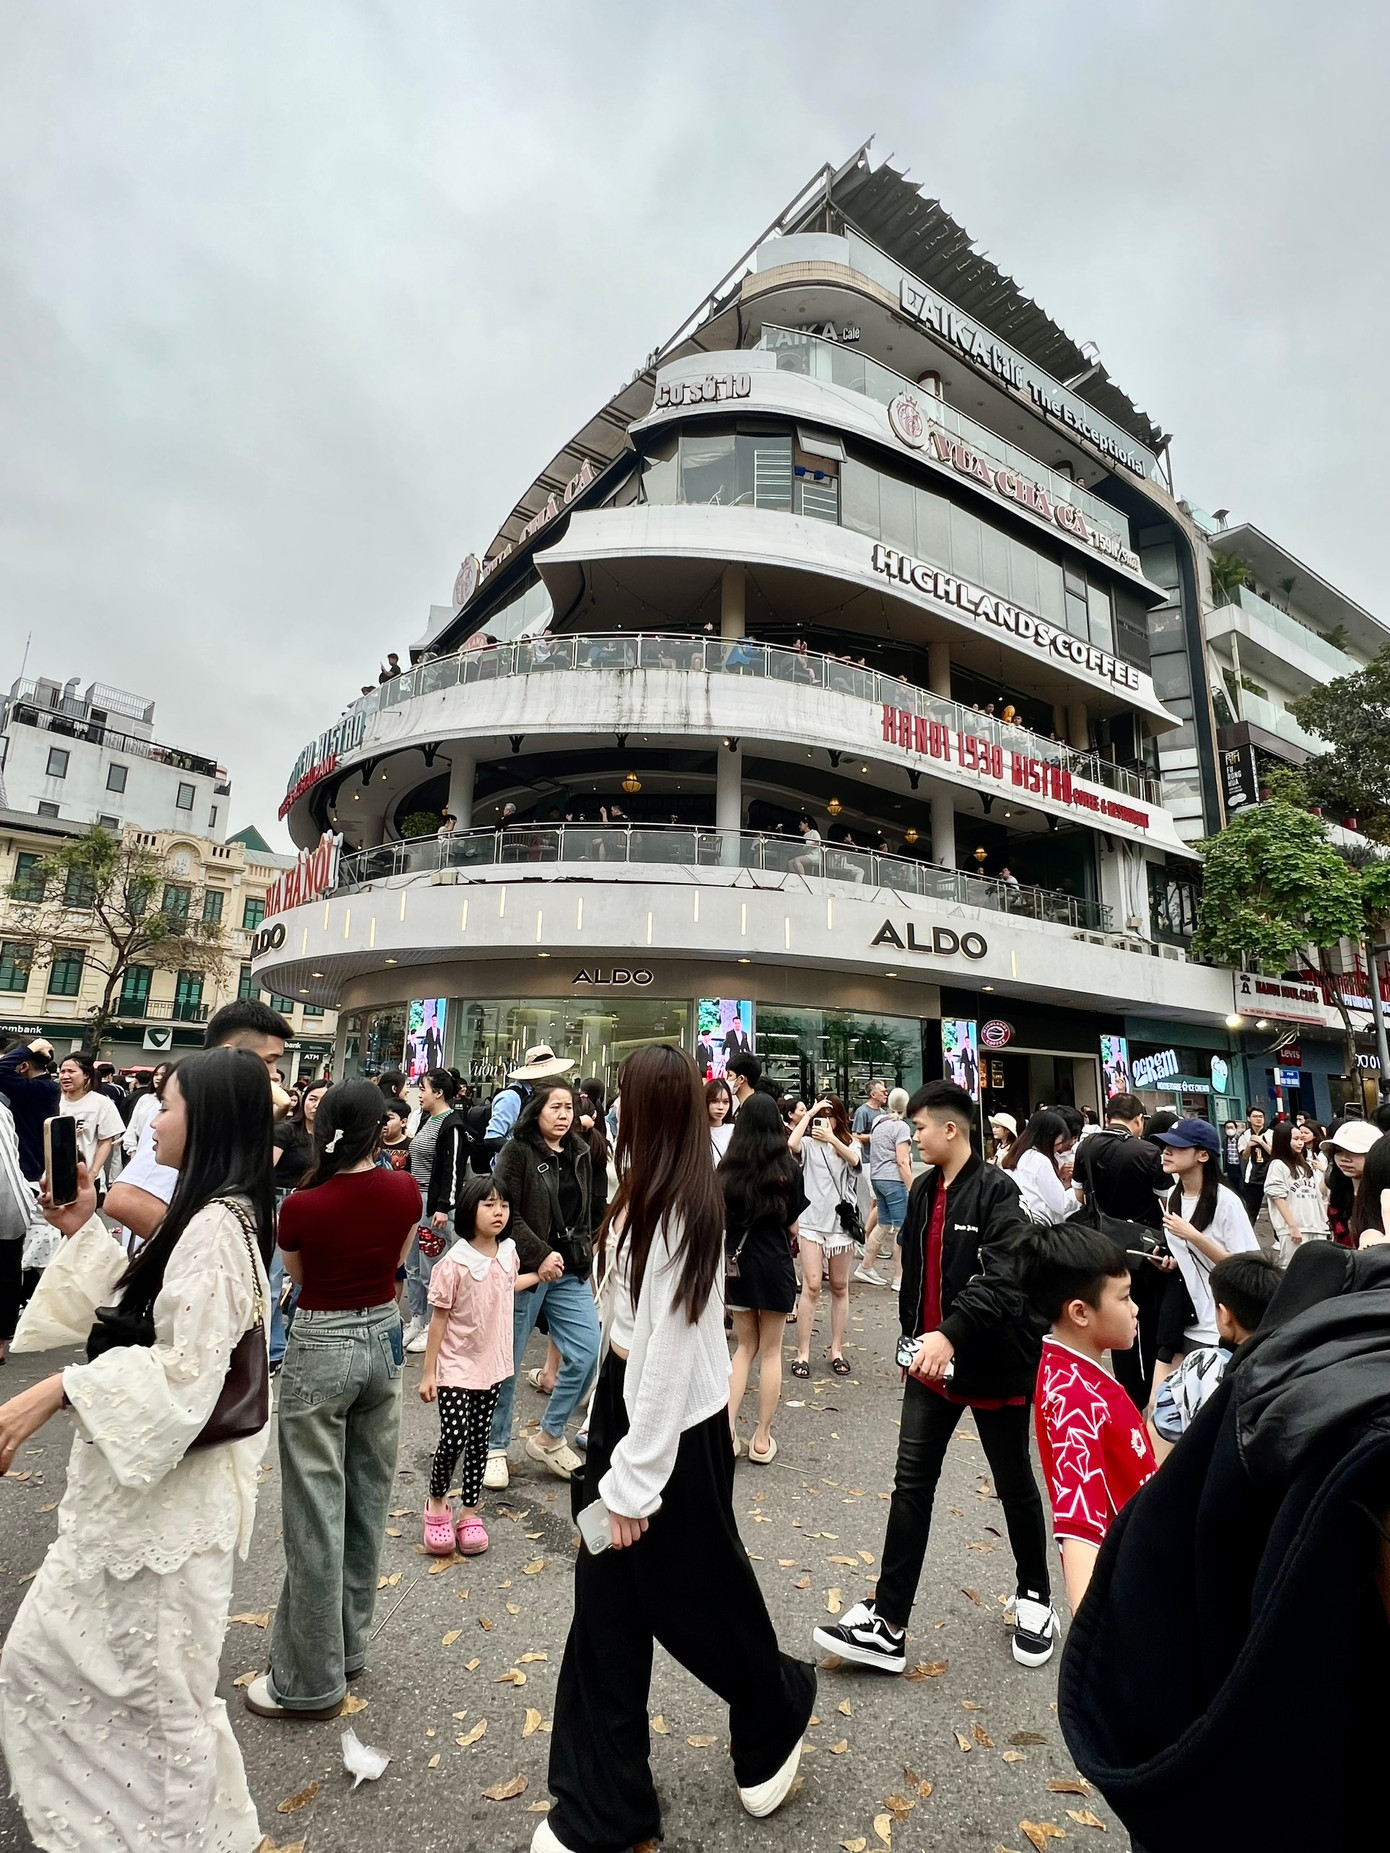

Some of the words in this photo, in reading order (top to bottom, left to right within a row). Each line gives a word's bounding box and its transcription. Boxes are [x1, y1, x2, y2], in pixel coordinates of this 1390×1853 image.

[721, 373, 751, 400] 10
[900, 278, 990, 368] LAIKA
[990, 344, 1024, 389] Café
[1028, 380, 1062, 415] The
[1062, 404, 1147, 479] Exceptional
[931, 432, 993, 488] VUA
[993, 471, 1053, 522] CHẢ
[871, 544, 1051, 647] HIGHLANDS
[1050, 632, 1140, 690] COFFEE
[882, 704, 951, 762] HANOI
[956, 731, 1004, 779] 1930
[1011, 751, 1072, 804] BISTRO
[869, 919, 988, 960] ALDO
[571, 968, 655, 986] ALDO
[1254, 1148, 1264, 1163] 1
